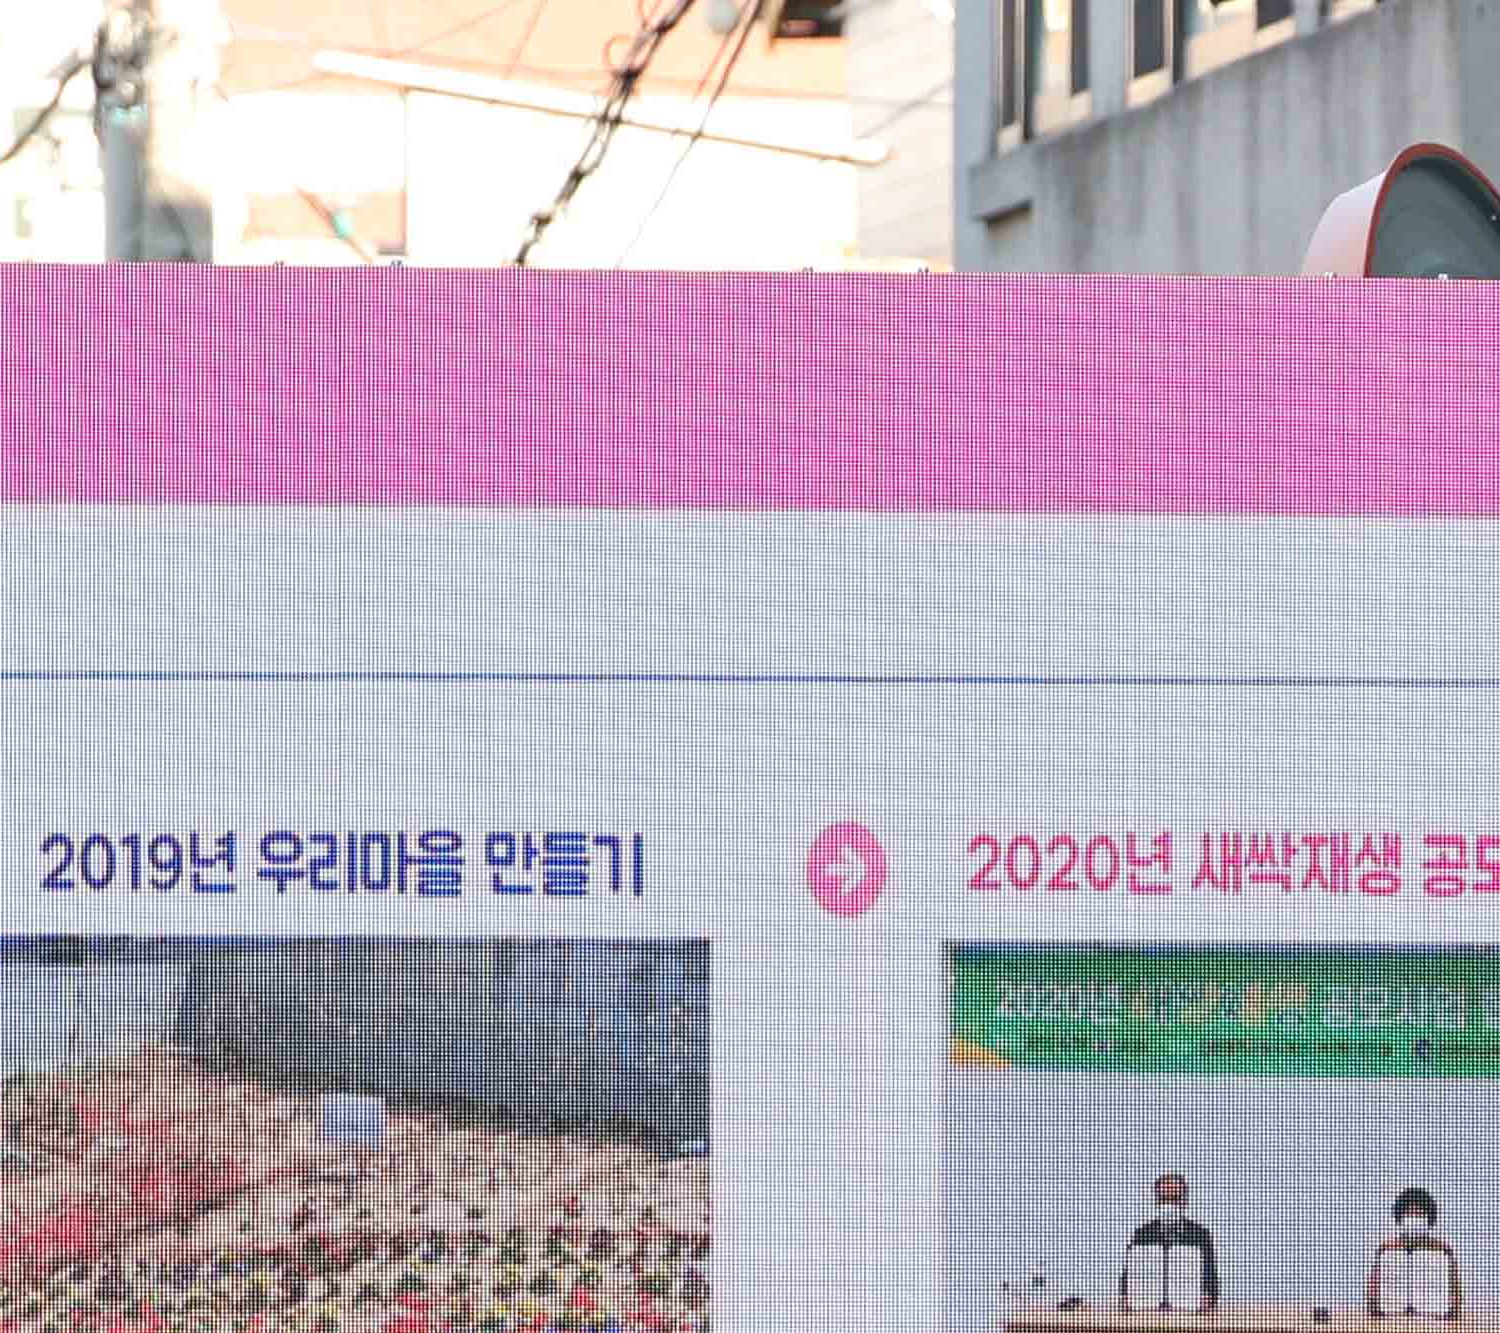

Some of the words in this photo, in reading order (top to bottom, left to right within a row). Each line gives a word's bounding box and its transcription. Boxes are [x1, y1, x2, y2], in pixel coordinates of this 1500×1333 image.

[39, 829, 238, 896] 2019년
[256, 829, 466, 898] 우리마을
[484, 830, 645, 899] 만들기
[966, 831, 1174, 896] 2020년
[1191, 830, 1403, 899] 새싹재생
